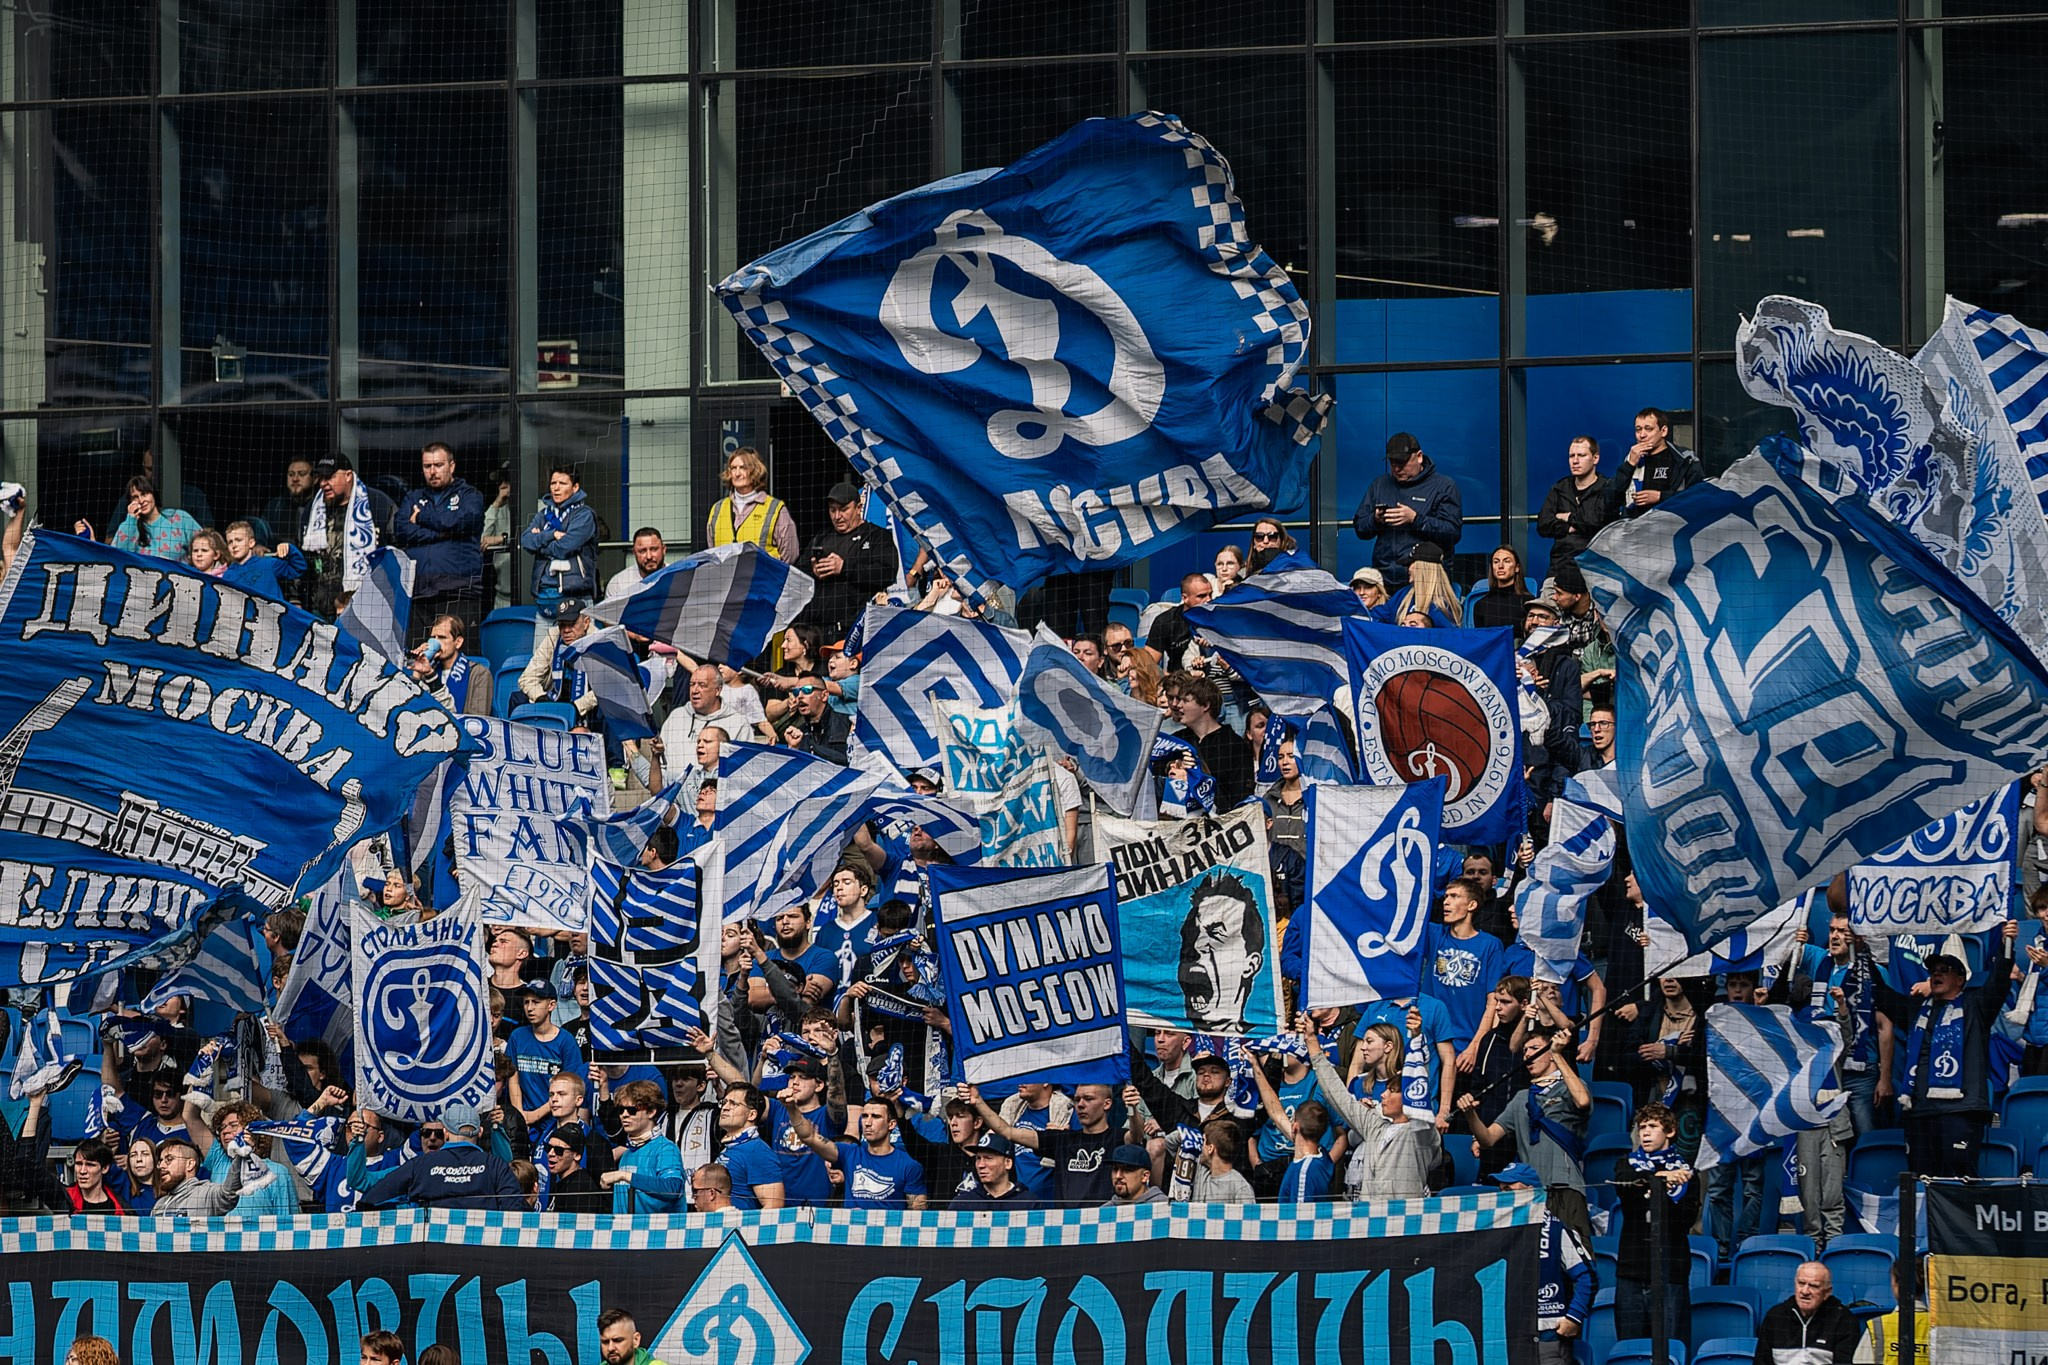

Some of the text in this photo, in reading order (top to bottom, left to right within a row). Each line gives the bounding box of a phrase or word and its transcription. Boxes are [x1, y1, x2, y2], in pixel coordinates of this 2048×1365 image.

[22, 563, 459, 757] ДИНАМО
[1398, 650, 1480, 685] MOSCOW
[1474, 682, 1508, 730] FANS
[94, 660, 353, 791] МОСКВА
[457, 716, 602, 782] BLUE
[1466, 794, 1488, 816] IN
[1485, 746, 1511, 793] 1976
[1110, 817, 1225, 873] ПОЙ ЗА
[1116, 820, 1256, 904] ДИНАМО
[525, 871, 575, 919] 1976
[951, 903, 1113, 983] DYNAMO
[960, 963, 1119, 1045] MOSCOW
[1975, 1204, 2022, 1232] Мы
[1948, 1274, 2028, 1312] Бога,
